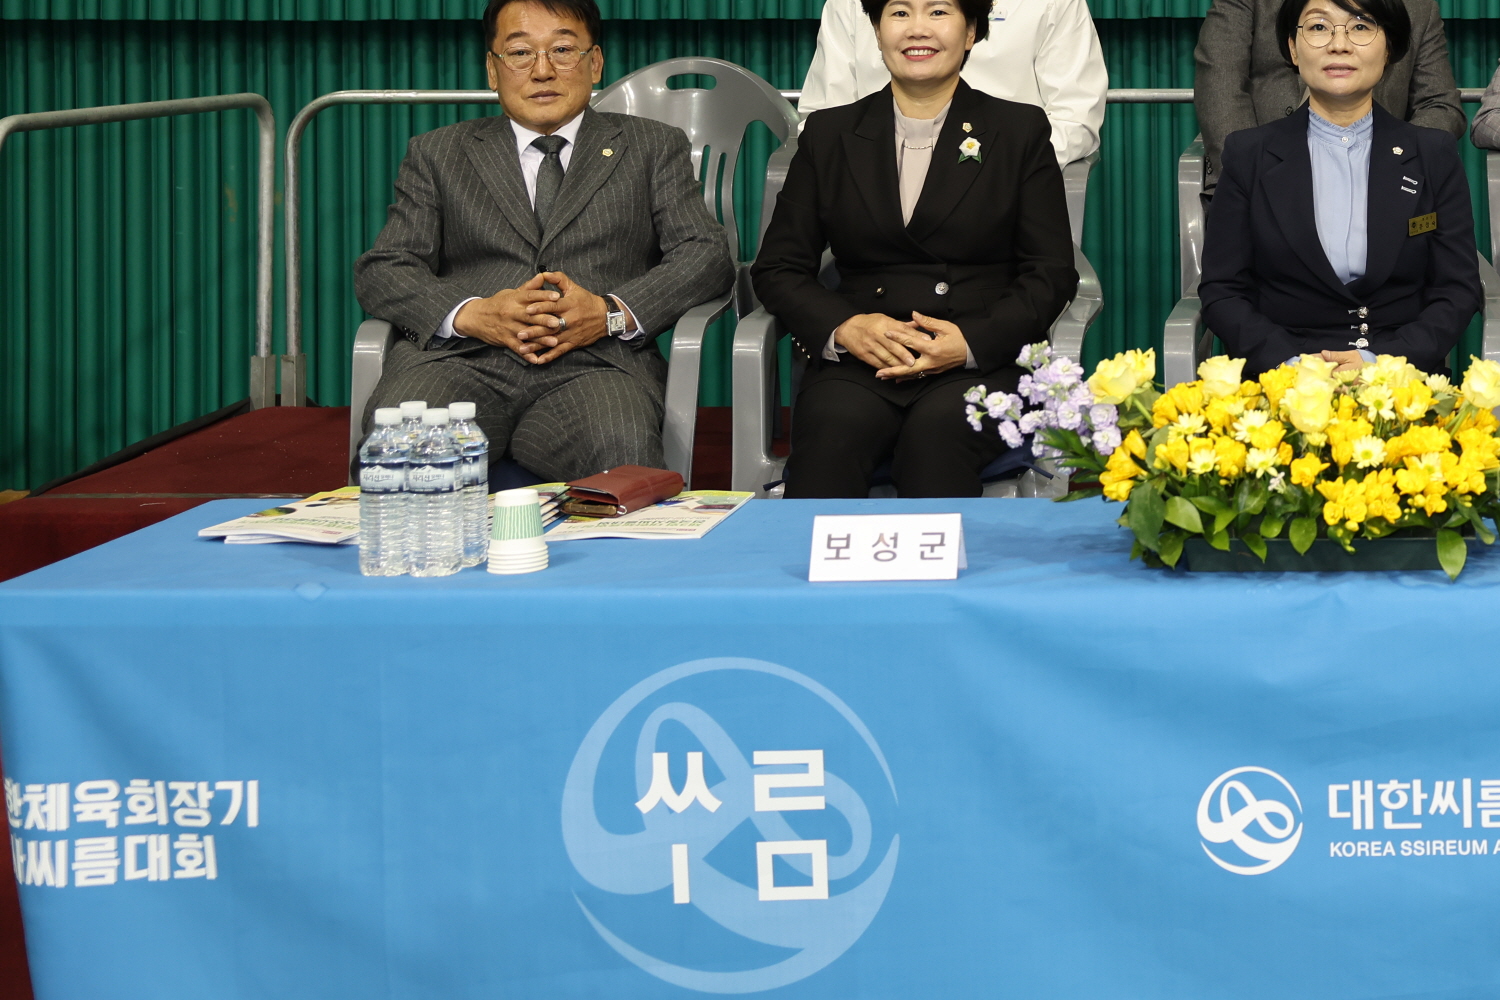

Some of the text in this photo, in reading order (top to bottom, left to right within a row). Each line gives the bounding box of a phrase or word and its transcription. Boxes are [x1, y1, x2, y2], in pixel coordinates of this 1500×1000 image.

[824, 532, 946, 562] 보성군
[1329, 841, 1396, 858] KOREA
[1400, 838, 1488, 856] SSIREUM
